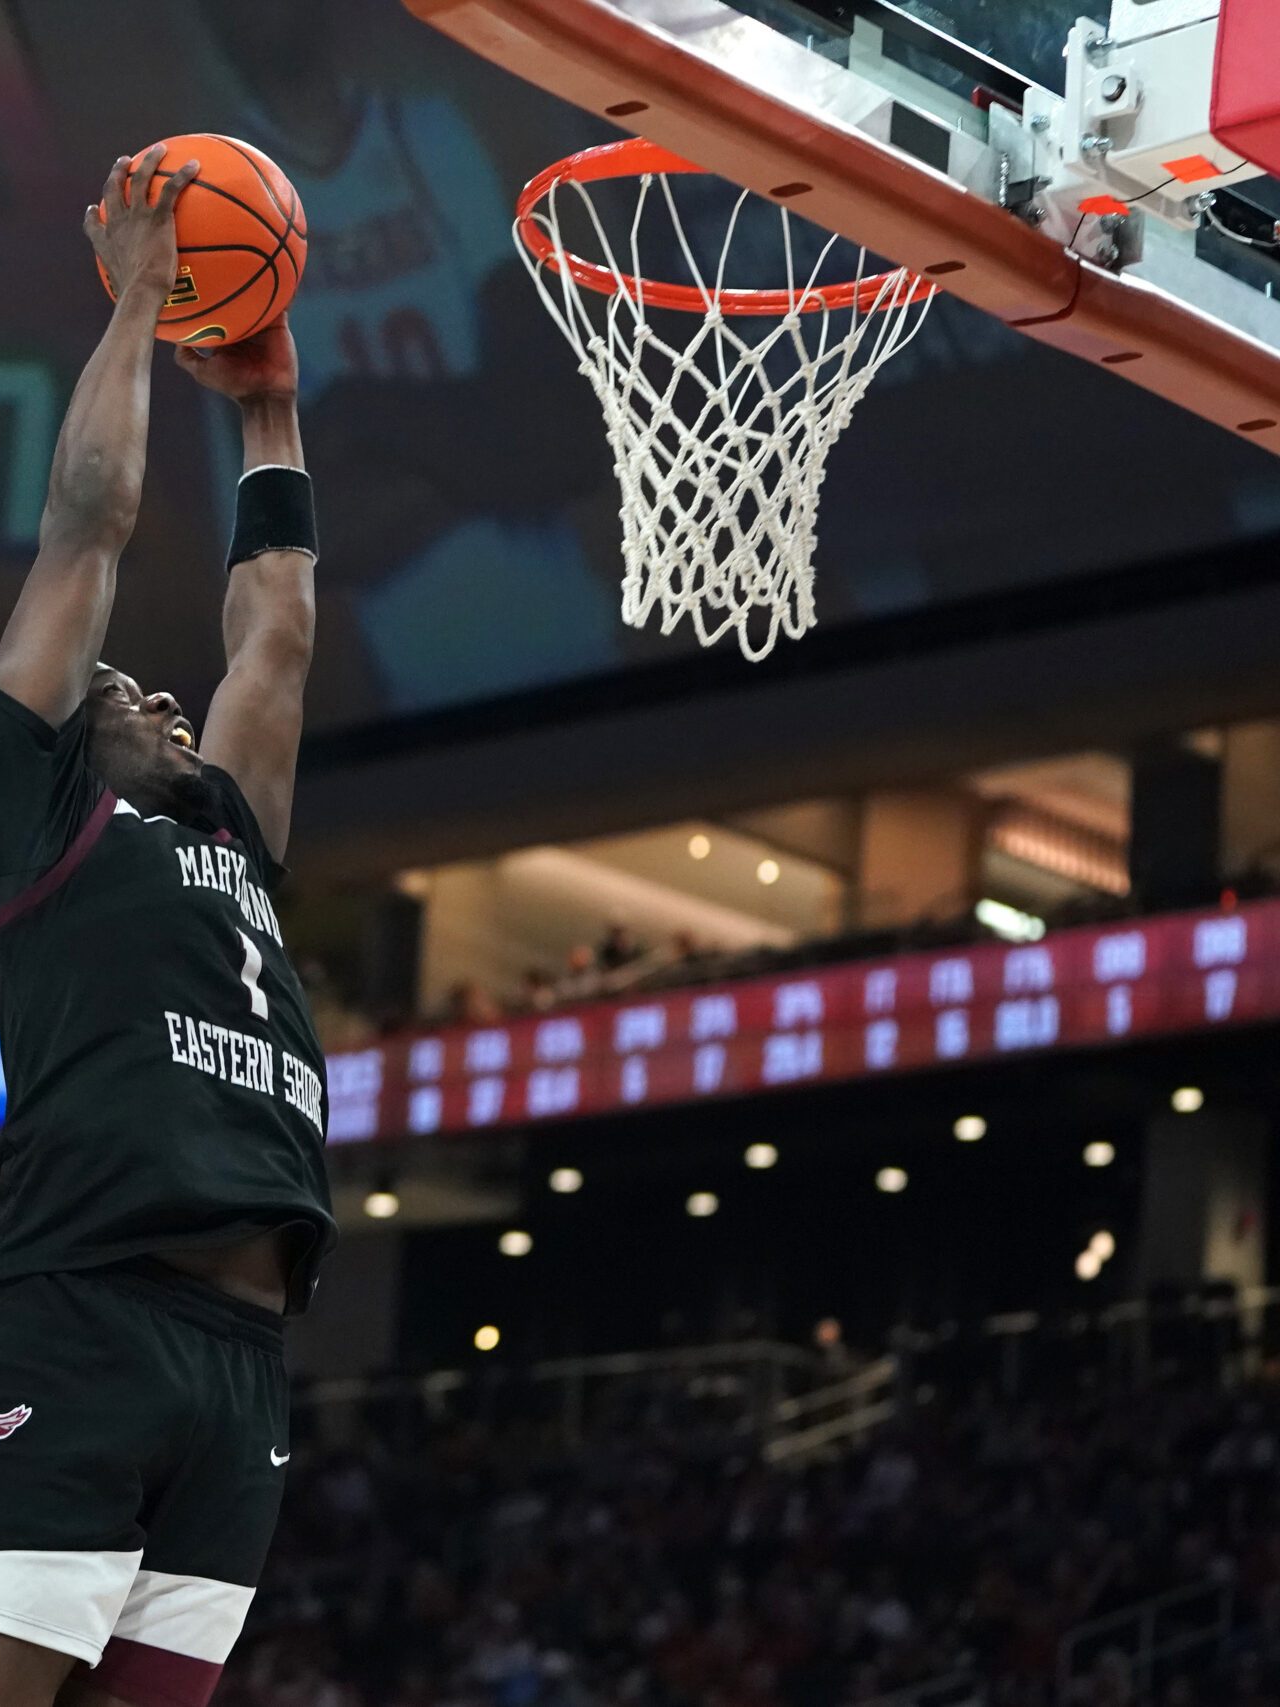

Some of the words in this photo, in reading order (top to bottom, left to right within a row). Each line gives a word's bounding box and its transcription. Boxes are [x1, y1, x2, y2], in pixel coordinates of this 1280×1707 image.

[175, 845, 283, 948] MARYAND
[235, 926, 269, 1021] 1
[164, 1011, 275, 1096] EASTERN
[282, 1051, 324, 1138] SHOR
